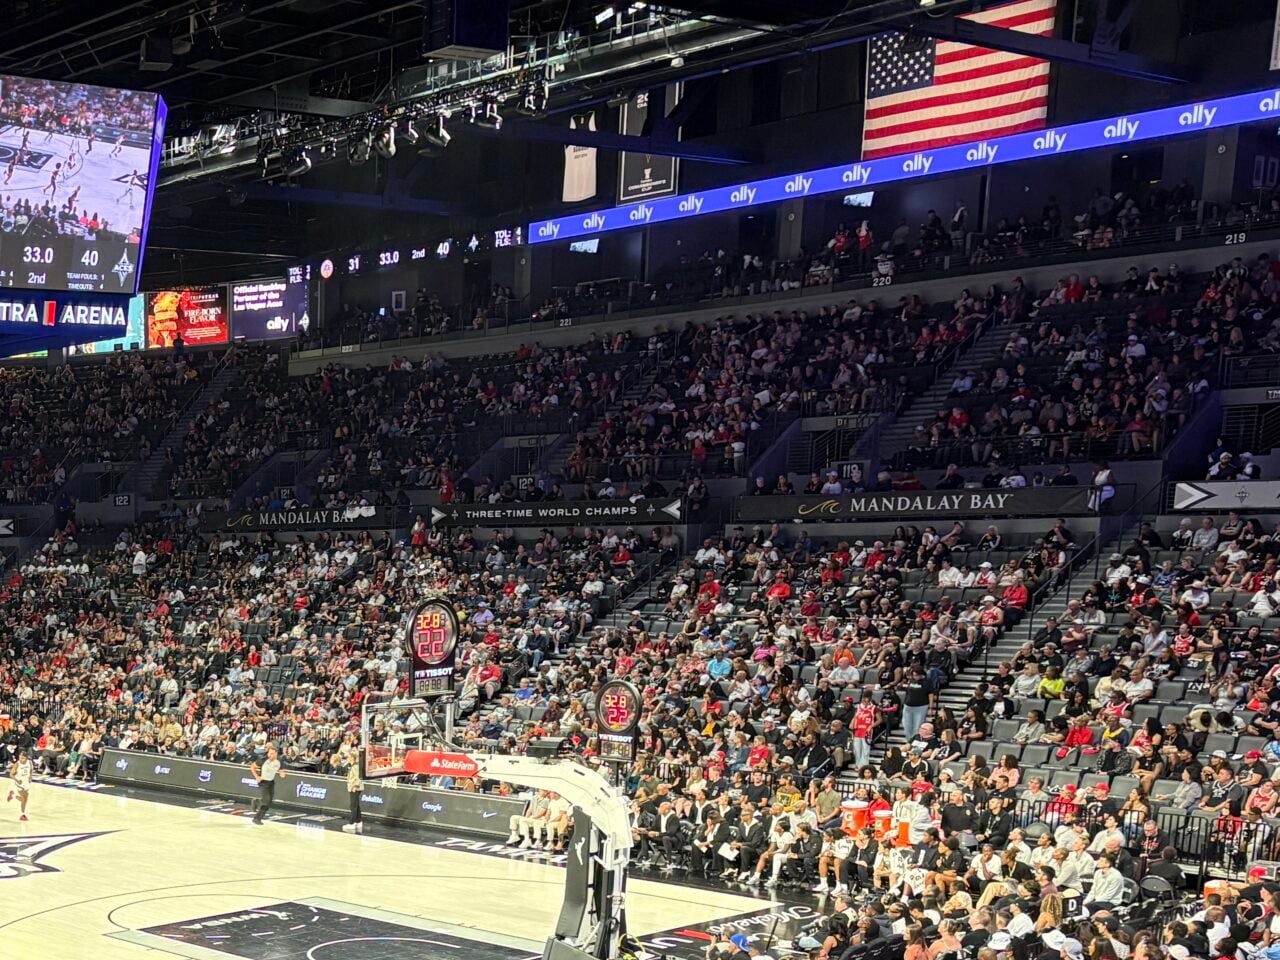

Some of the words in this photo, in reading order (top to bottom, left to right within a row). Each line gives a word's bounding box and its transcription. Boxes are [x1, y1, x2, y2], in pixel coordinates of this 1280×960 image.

[1178, 104, 1217, 126] ally
[1103, 118, 1140, 139] ally
[1033, 130, 1067, 151] ally
[966, 142, 998, 163] ally
[902, 153, 933, 173] ally
[842, 164, 872, 183] ally
[784, 174, 813, 194] ally
[730, 184, 757, 203] ally
[678, 194, 703, 212] ally
[629, 203, 653, 222] ally
[582, 212, 606, 230] ally
[495, 230, 511, 239] TOL:
[516, 227, 521, 236] 4
[538, 220, 560, 237] ally
[496, 238, 511, 247] FLS:
[1224, 232, 1246, 245] 219
[22, 246, 54, 263] 33.0
[411, 249, 425, 259] 2nd
[436, 241, 450, 255] 40
[81, 250, 98, 266] 40
[348, 257, 360, 271] 31
[379, 251, 399, 265] 33.0
[289, 267, 302, 275] TOL:
[27, 272, 46, 285] 2nd
[290, 276, 302, 284] FLS:
[872, 276, 892, 287] 220
[68, 282, 94, 290] TIMEOUTS:
[233, 285, 258, 295] Official
[258, 283, 286, 293] Banking
[234, 293, 258, 303] Partner
[259, 292, 268, 300] of
[268, 291, 280, 299] the
[233, 302, 246, 311] Las
[246, 301, 266, 311] Vegas
[60, 305, 126, 325] ARENA
[266, 316, 289, 332] ally
[115, 495, 129, 506] 122
[850, 494, 964, 512] MANDALAY
[259, 511, 331, 525] MANDALAY
[466, 509, 533, 518] THREE-TIME
[538, 508, 580, 517] WORLD
[585, 506, 638, 515] CHAMPS
[416, 613, 440, 630] 32.8
[417, 629, 445, 658] 22
[426, 667, 454, 677] TISSOT
[605, 694, 627, 708] 32.8
[608, 708, 628, 724] 22
[609, 734, 633, 743] TISSOT
[115, 759, 128, 770] ally
[422, 801, 443, 812] Google
[1069, 900, 1077, 911] D
